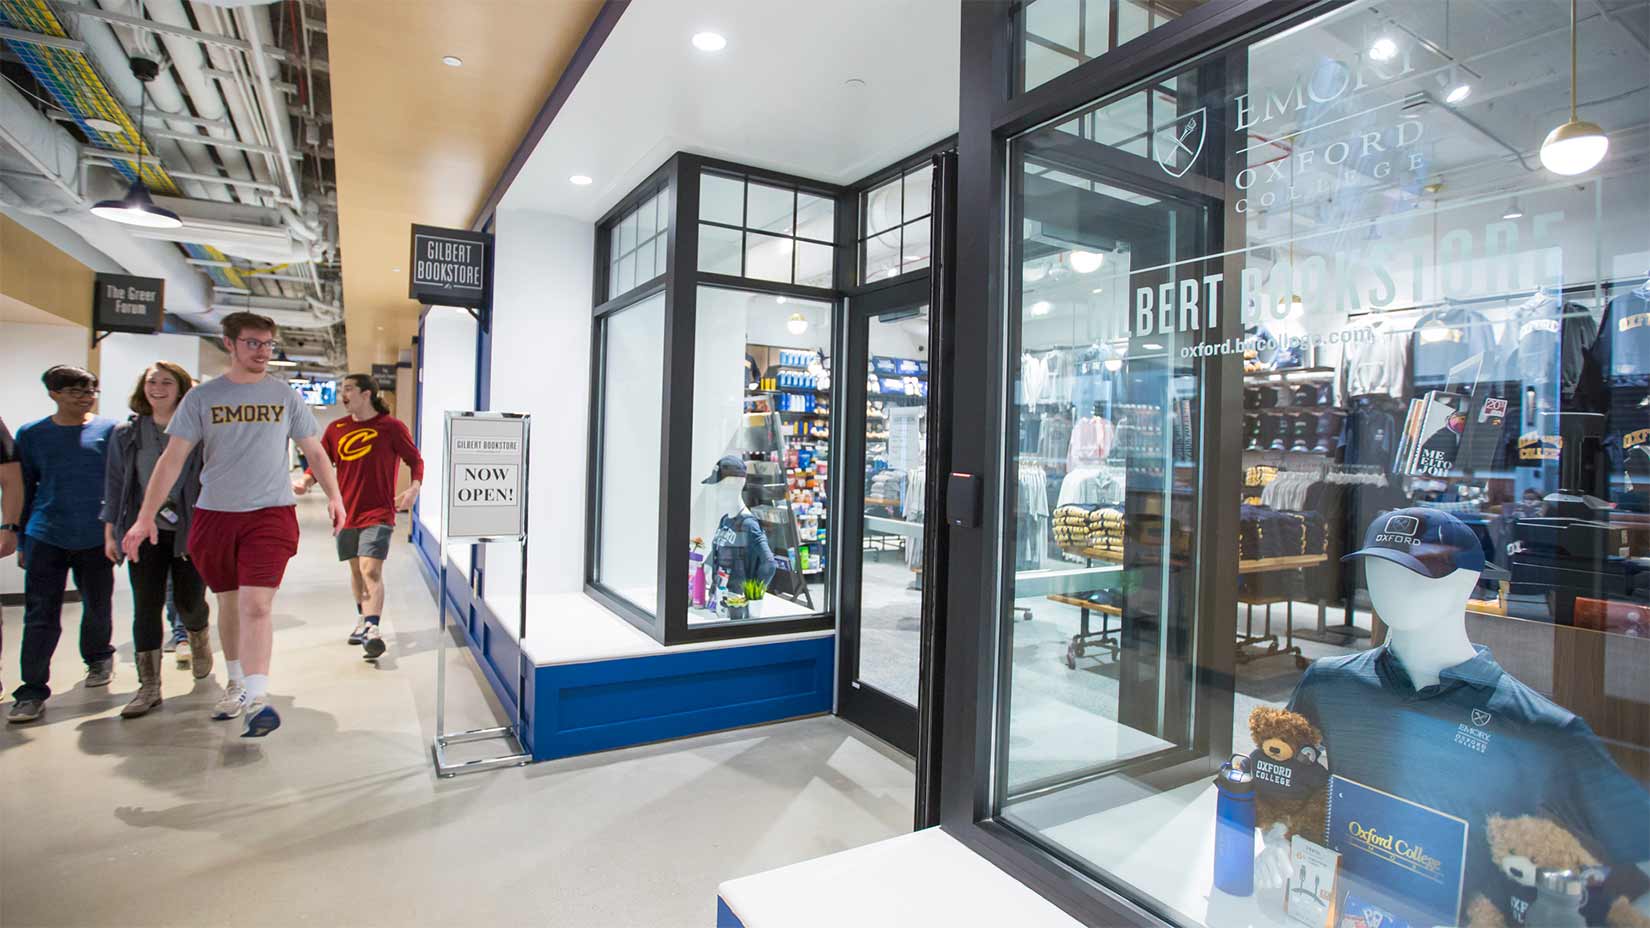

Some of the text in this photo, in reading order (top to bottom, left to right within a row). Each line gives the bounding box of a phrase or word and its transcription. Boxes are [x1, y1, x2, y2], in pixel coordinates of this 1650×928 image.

[1235, 120, 1424, 190] OXFORD
[427, 240, 472, 264] GILBERT
[417, 260, 480, 285] BOOKSTORE
[106, 284, 126, 299] The
[210, 404, 285, 425] EMORY
[456, 440, 518, 451] GILBERT BOOKSTORE
[464, 468, 510, 482] NOW
[457, 488, 513, 502] OPEN!
[1375, 534, 1422, 546] OXFORD
[1256, 760, 1292, 779] OXFORD
[1255, 770, 1292, 788] COLLEGE
[1348, 820, 1393, 851] Oxford
[1394, 839, 1441, 871] College
